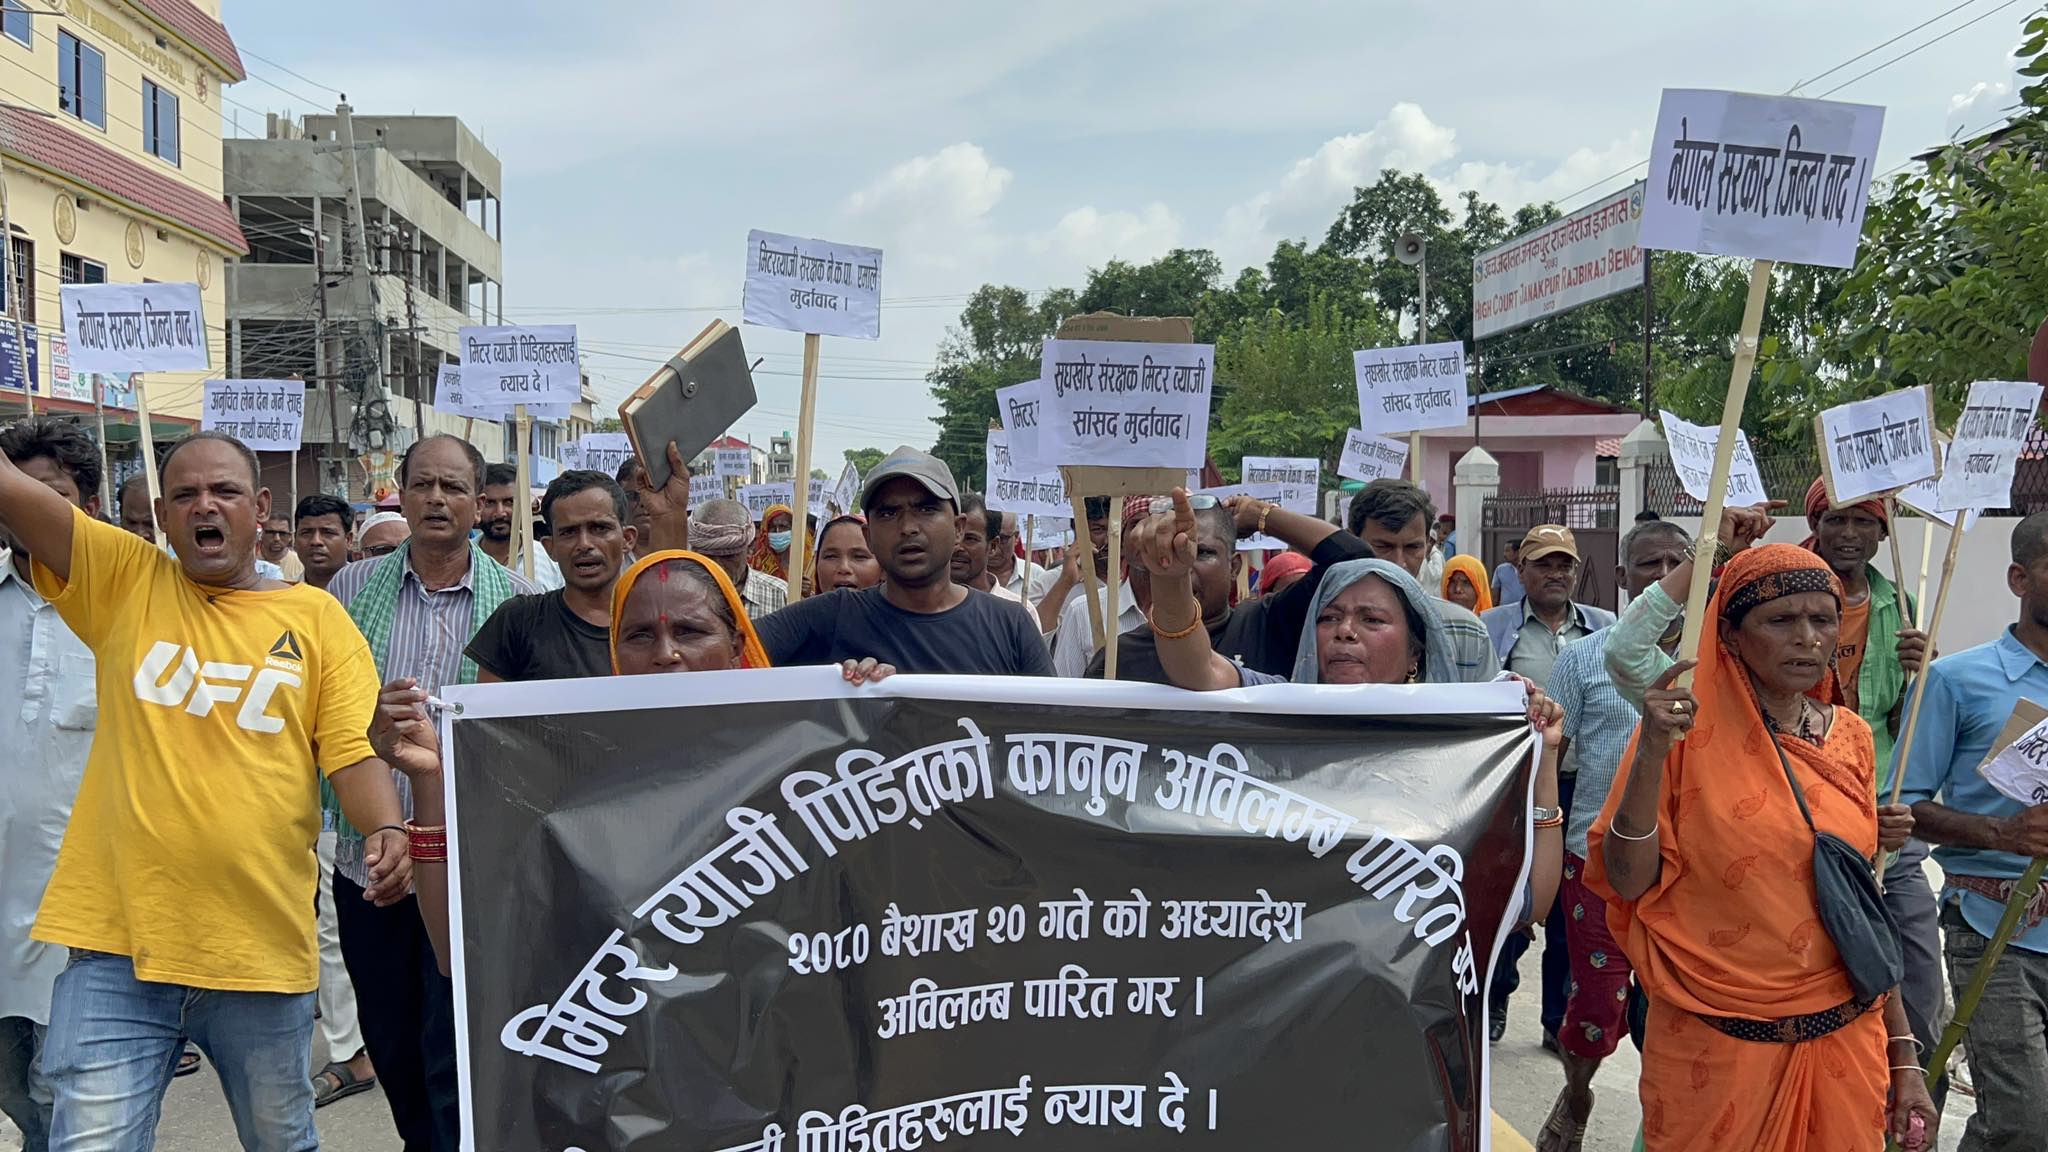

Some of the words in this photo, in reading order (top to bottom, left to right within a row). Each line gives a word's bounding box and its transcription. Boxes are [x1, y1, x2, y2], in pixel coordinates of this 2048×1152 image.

[1667, 116, 1720, 211] नेपाल
[1717, 144, 1782, 219] सरकार
[1773, 124, 1827, 225] जिन्दा
[789, 288, 839, 311] मुर्दावाद
[1475, 298, 1492, 321] HIGH
[1492, 288, 1519, 316] COURT
[1519, 274, 1561, 306] JANAKPUR
[1561, 254, 1606, 291] RAJBIRAJ
[1607, 244, 1643, 275] BENCH
[77, 299, 108, 351] नेपाल
[107, 311, 145, 351] सरकार
[468, 335, 492, 365] मिटर
[1392, 358, 1418, 382] संरक्षक
[1418, 353, 1439, 379] मिटर
[499, 374, 529, 393] न्याय
[532, 369, 541, 393] दे
[1098, 357, 1140, 395] संरक्षक
[1141, 354, 1172, 395] मिटर
[210, 384, 239, 416] अनुचित
[240, 386, 255, 412] लेन
[1008, 397, 1038, 430] मिटर
[1382, 391, 1412, 414] सांसद
[1414, 386, 1452, 414] मुर्दावाद
[1073, 406, 1120, 438] सांसद
[1124, 406, 1183, 444] मुर्दावाद
[1834, 425, 1855, 474] नेपाल
[1852, 428, 1888, 473] सरकार
[995, 478, 1021, 502] महाजन
[264, 656, 303, 672] Reebok
[134, 640, 302, 734] UFC
[500, 928, 679, 1074] मिटर
[1005, 732, 1148, 817] कानुन
[1155, 742, 1359, 859] अविलम्ब
[1345, 826, 1466, 948] पारित
[788, 923, 870, 975] २०८०
[881, 902, 979, 957] बैशाख
[986, 903, 1026, 945] २०
[1039, 888, 1094, 941] गते
[1103, 888, 1151, 939] को
[1161, 889, 1307, 945] अध्यादेश
[877, 977, 1014, 1039] अविलम्ब
[1024, 964, 1118, 1019] पारित
[1127, 976, 1181, 1018] गर
[1044, 1084, 1147, 1127] न्याय
[1158, 1072, 1190, 1134] दे
